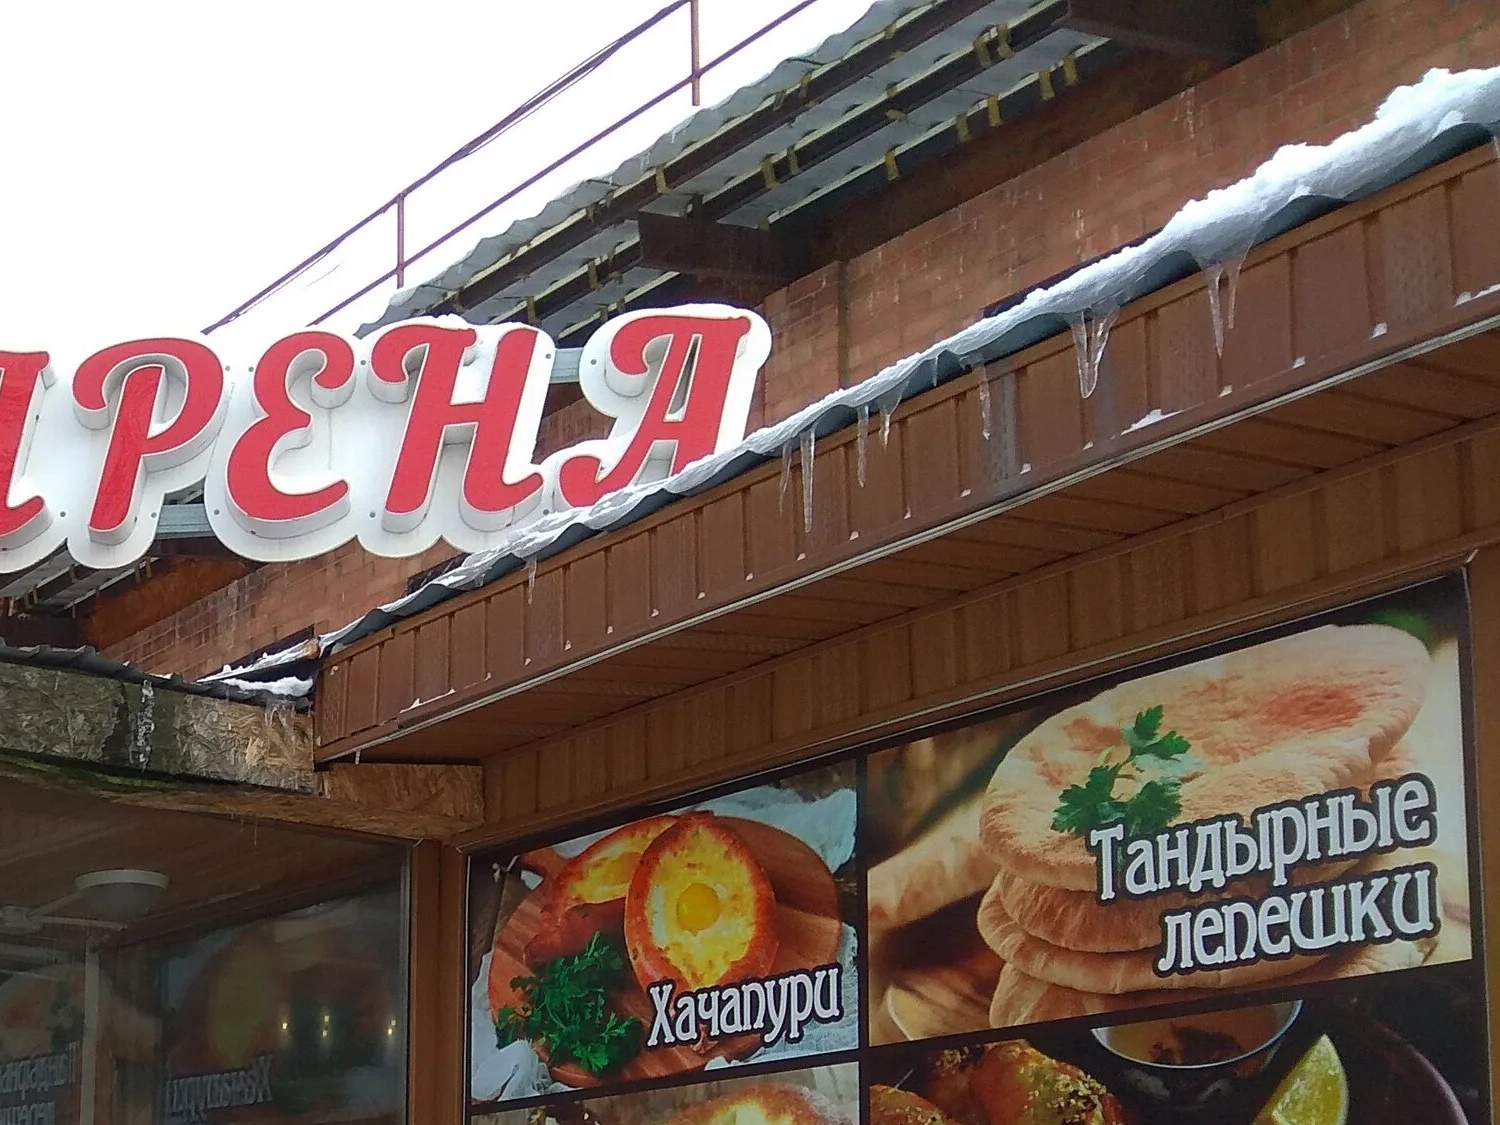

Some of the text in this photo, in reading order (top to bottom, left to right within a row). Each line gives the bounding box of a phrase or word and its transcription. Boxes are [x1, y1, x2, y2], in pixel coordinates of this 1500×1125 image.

[1090, 779, 1431, 901] Тандырные
[1157, 869, 1435, 973] лепешки
[646, 967, 841, 1047] Хачапури
